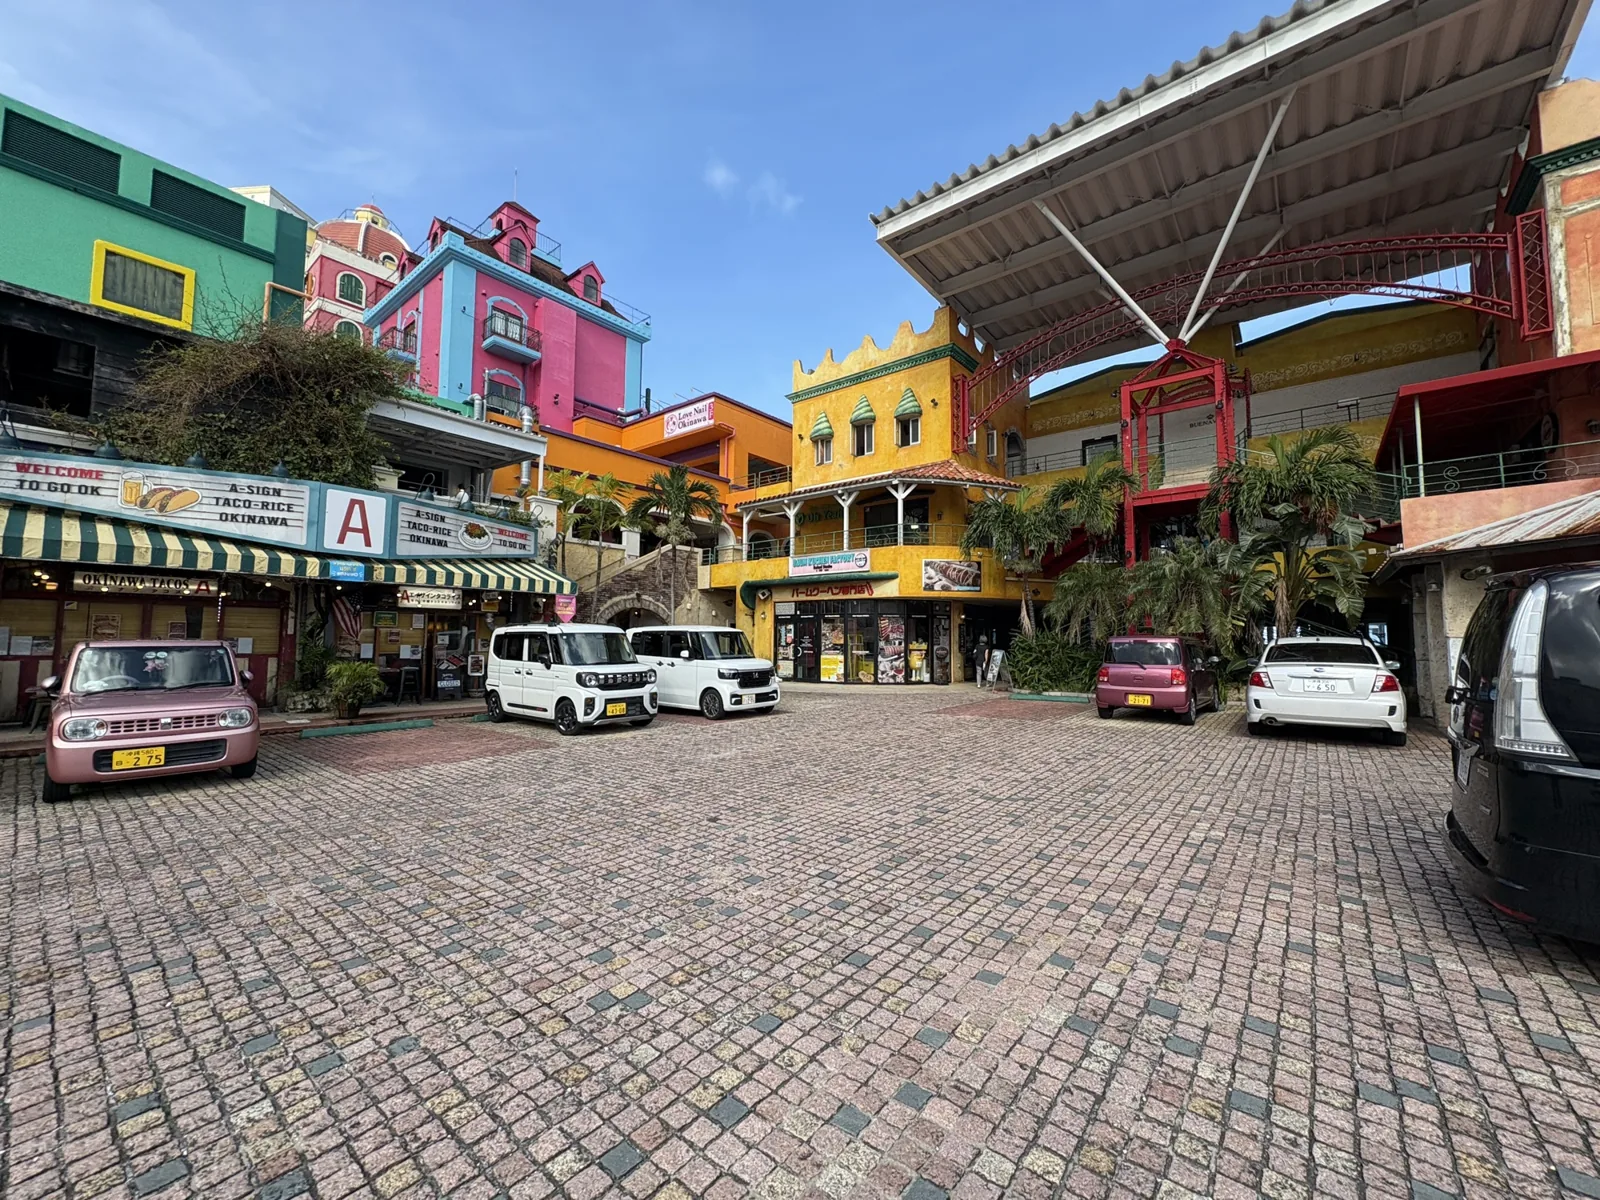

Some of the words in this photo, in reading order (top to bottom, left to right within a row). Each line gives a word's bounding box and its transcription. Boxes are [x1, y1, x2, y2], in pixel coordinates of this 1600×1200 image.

[678, 411, 693, 421] Love
[693, 404, 707, 416] Nail
[677, 416, 707, 429] Okinawa
[16, 463, 105, 480] WELCOME
[16, 479, 40, 491] TO
[47, 482, 71, 494] GO
[78, 484, 101, 496] OK
[229, 483, 282, 497] A-SIGN
[213, 496, 295, 513] TACO-RICE
[219, 512, 288, 527] OKINAWA
[336, 498, 372, 548] A
[415, 510, 446, 523] A-SIGN
[407, 521, 452, 537] TACO-RICE
[497, 528, 528, 540] WELCOME
[409, 534, 449, 548] OKINAWA
[499, 539, 508, 547] TO
[508, 541, 517, 549] GO
[518, 542, 527, 550] OK
[830, 553, 855, 565] FACTORY
[82, 572, 146, 588] OKINAWA
[150, 577, 190, 590] TACOS
